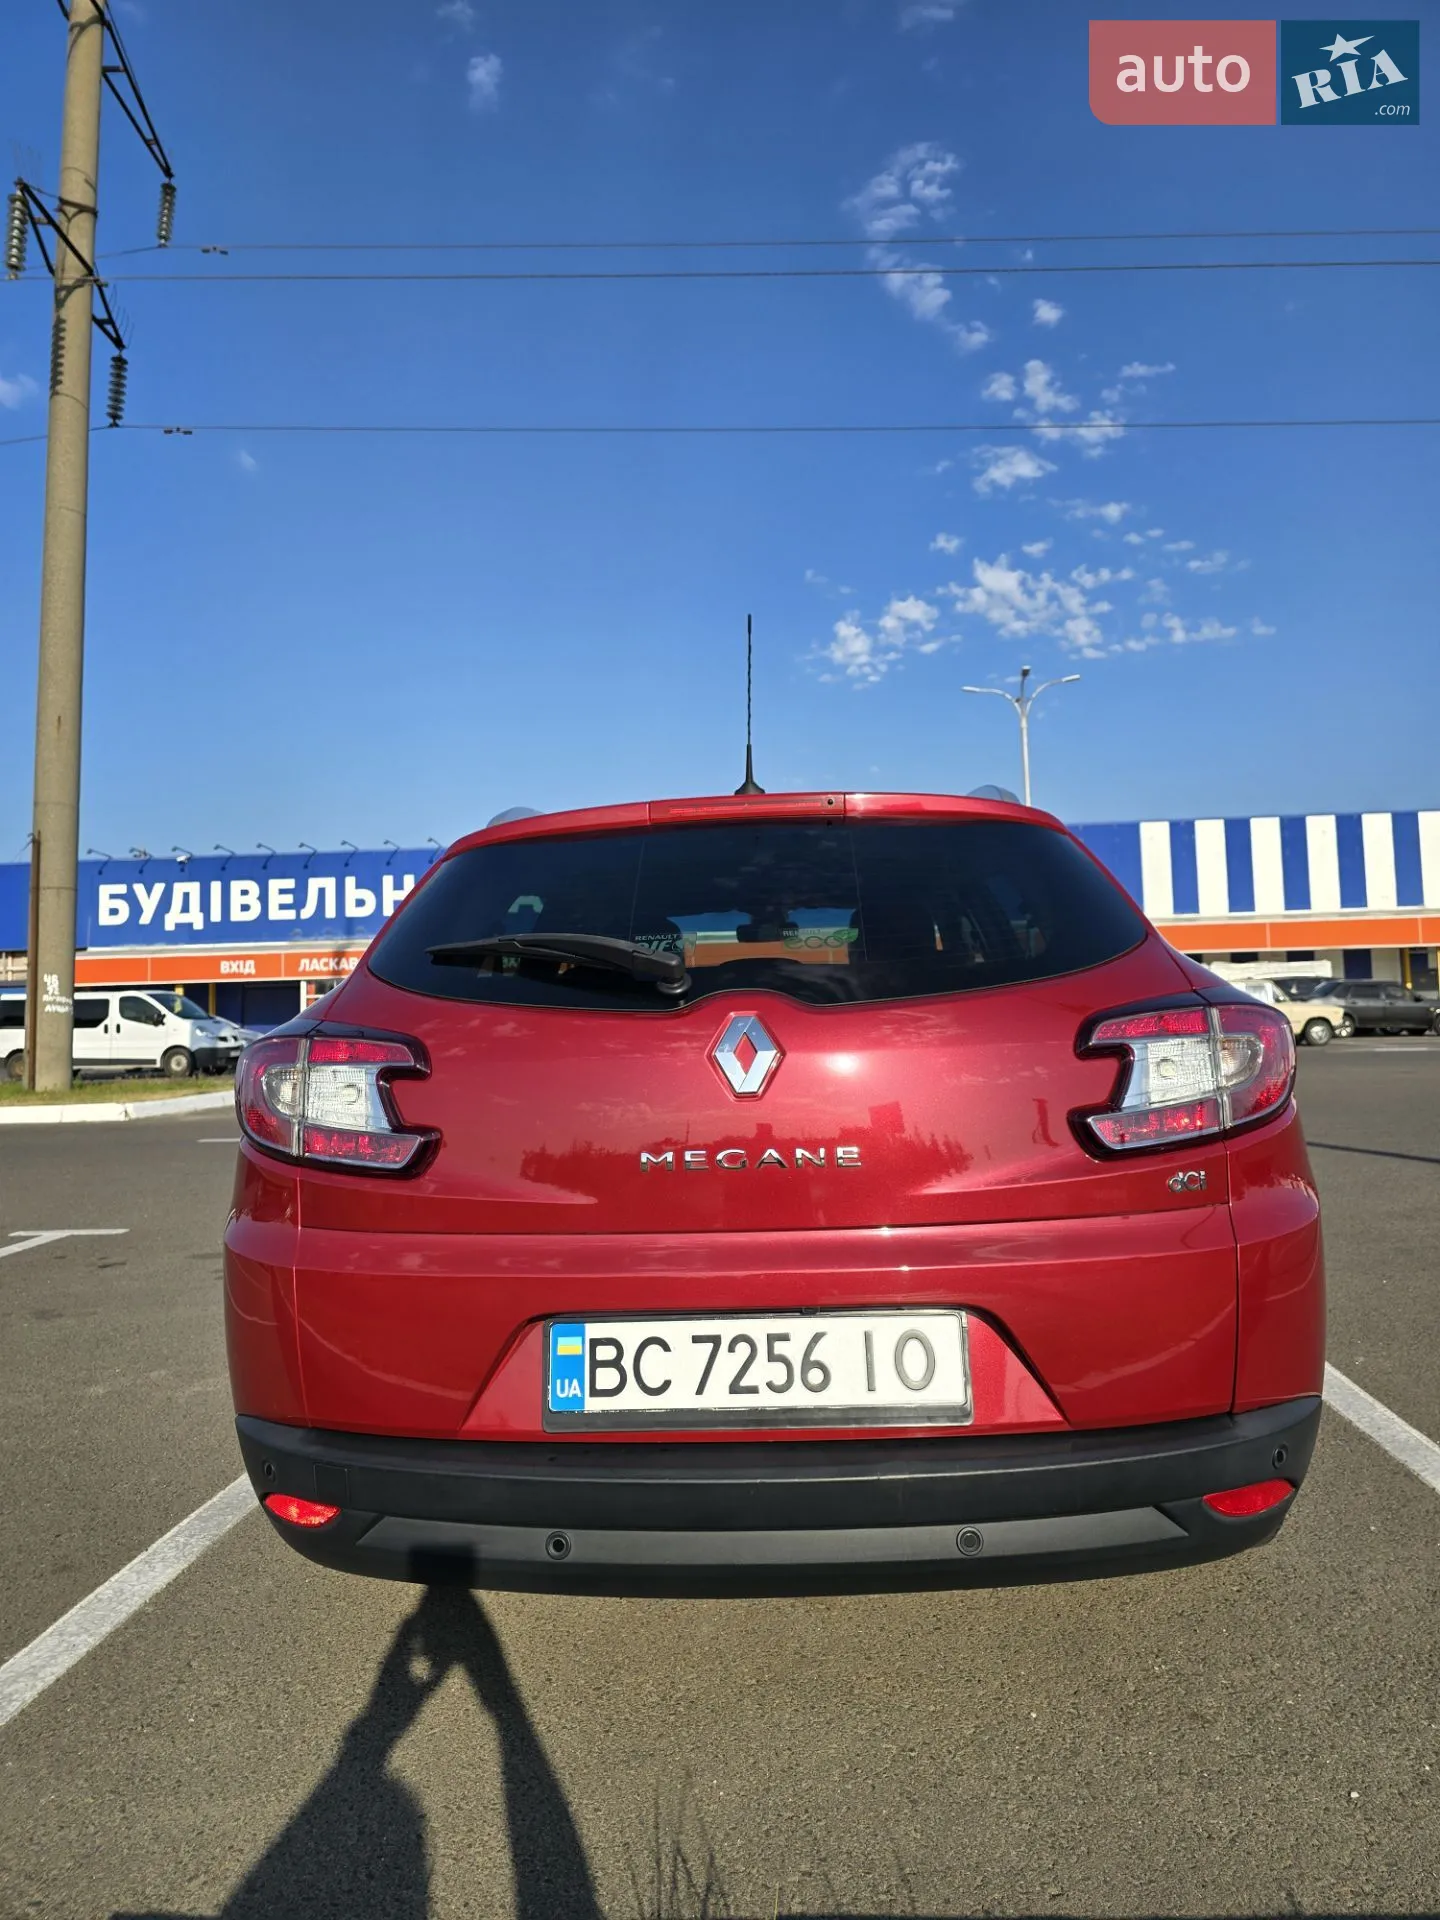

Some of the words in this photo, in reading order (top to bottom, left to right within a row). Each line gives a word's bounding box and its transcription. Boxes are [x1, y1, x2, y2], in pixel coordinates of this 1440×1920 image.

[220, 959, 256, 975] ВХІД
[639, 1146, 863, 1172] MEGANE
[588, 1336, 672, 1397] BC
[691, 1331, 832, 1395] 7256
[556, 1379, 581, 1398] UA
